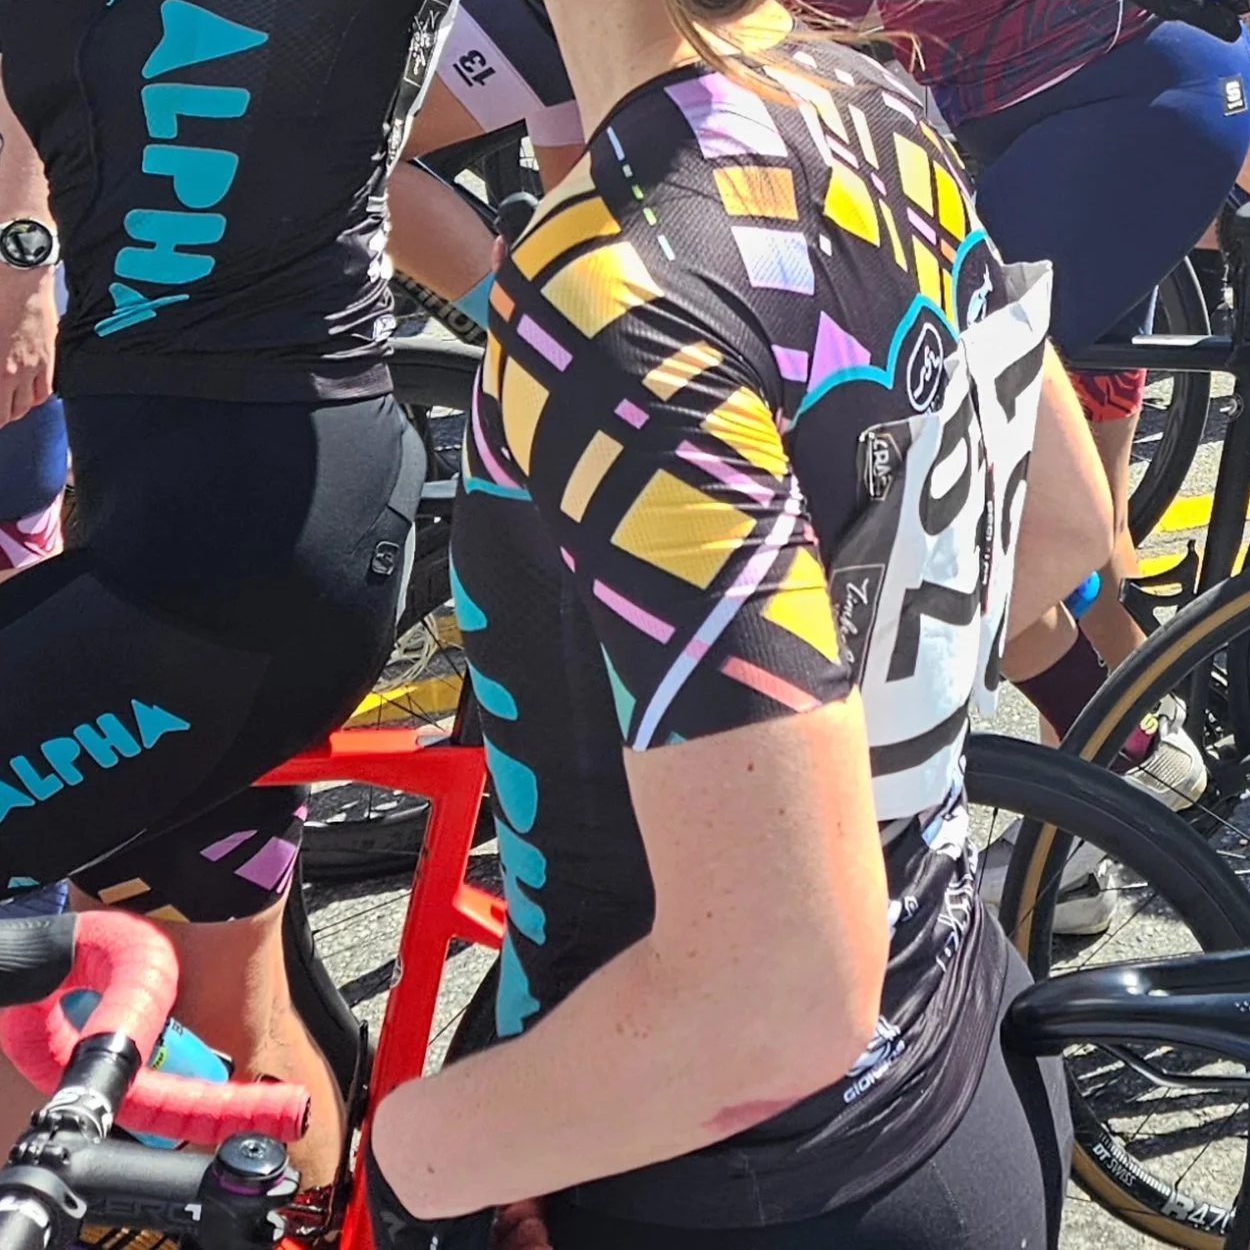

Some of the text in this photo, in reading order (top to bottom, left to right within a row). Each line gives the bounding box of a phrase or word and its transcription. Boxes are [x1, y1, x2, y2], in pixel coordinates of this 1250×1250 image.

[459, 49, 497, 87] 13
[1092, 1142, 1137, 1188] DT SWISS
